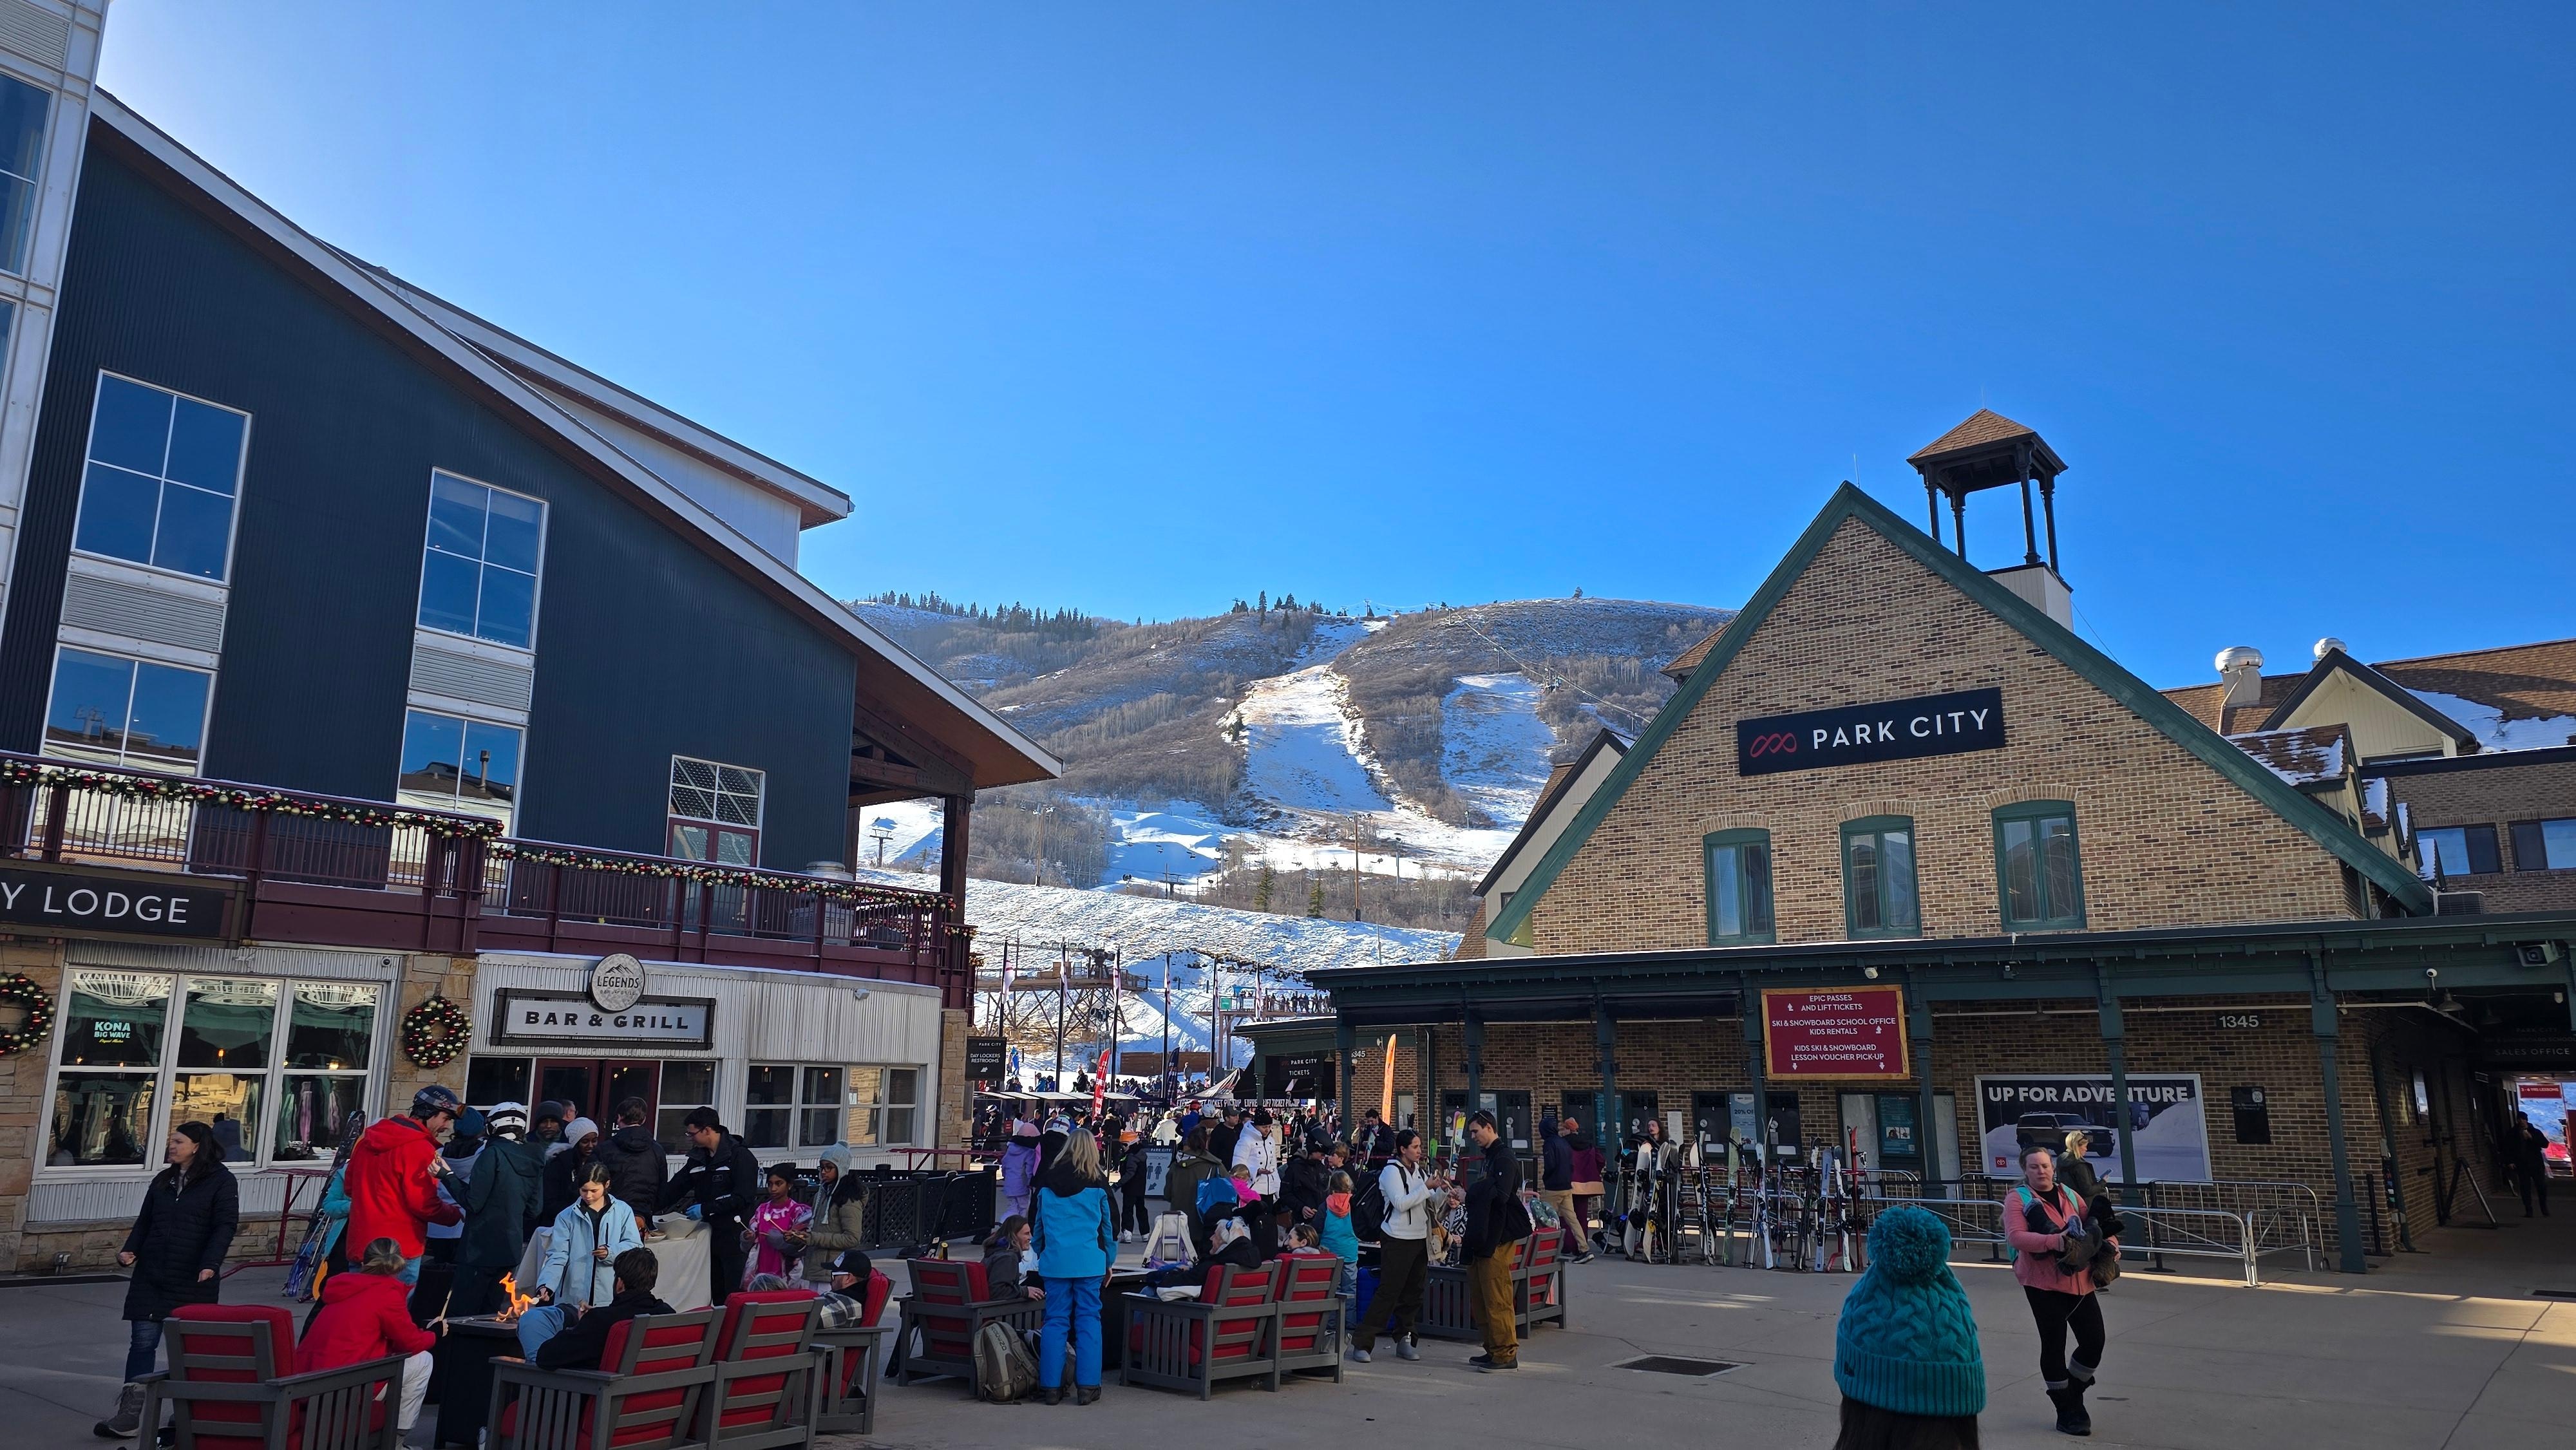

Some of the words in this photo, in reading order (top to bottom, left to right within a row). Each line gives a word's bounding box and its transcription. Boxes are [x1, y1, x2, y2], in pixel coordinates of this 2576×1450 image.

[1813, 720, 1895, 749] PARK
[1910, 708, 1989, 737] CITY
[43, 886, 189, 923] LODGE
[597, 975, 639, 988] LEGENDS
[94, 1021, 131, 1031] KONA
[525, 1011, 578, 1026] BAR
[588, 1013, 603, 1027] &
[613, 1015, 688, 1030] GRILL
[2219, 1015, 2260, 1028] 1345
[1988, 1087, 2014, 1102] UP
[2018, 1087, 2060, 1102] FOR
[1244, 1098, 1258, 1107] EXPRE
